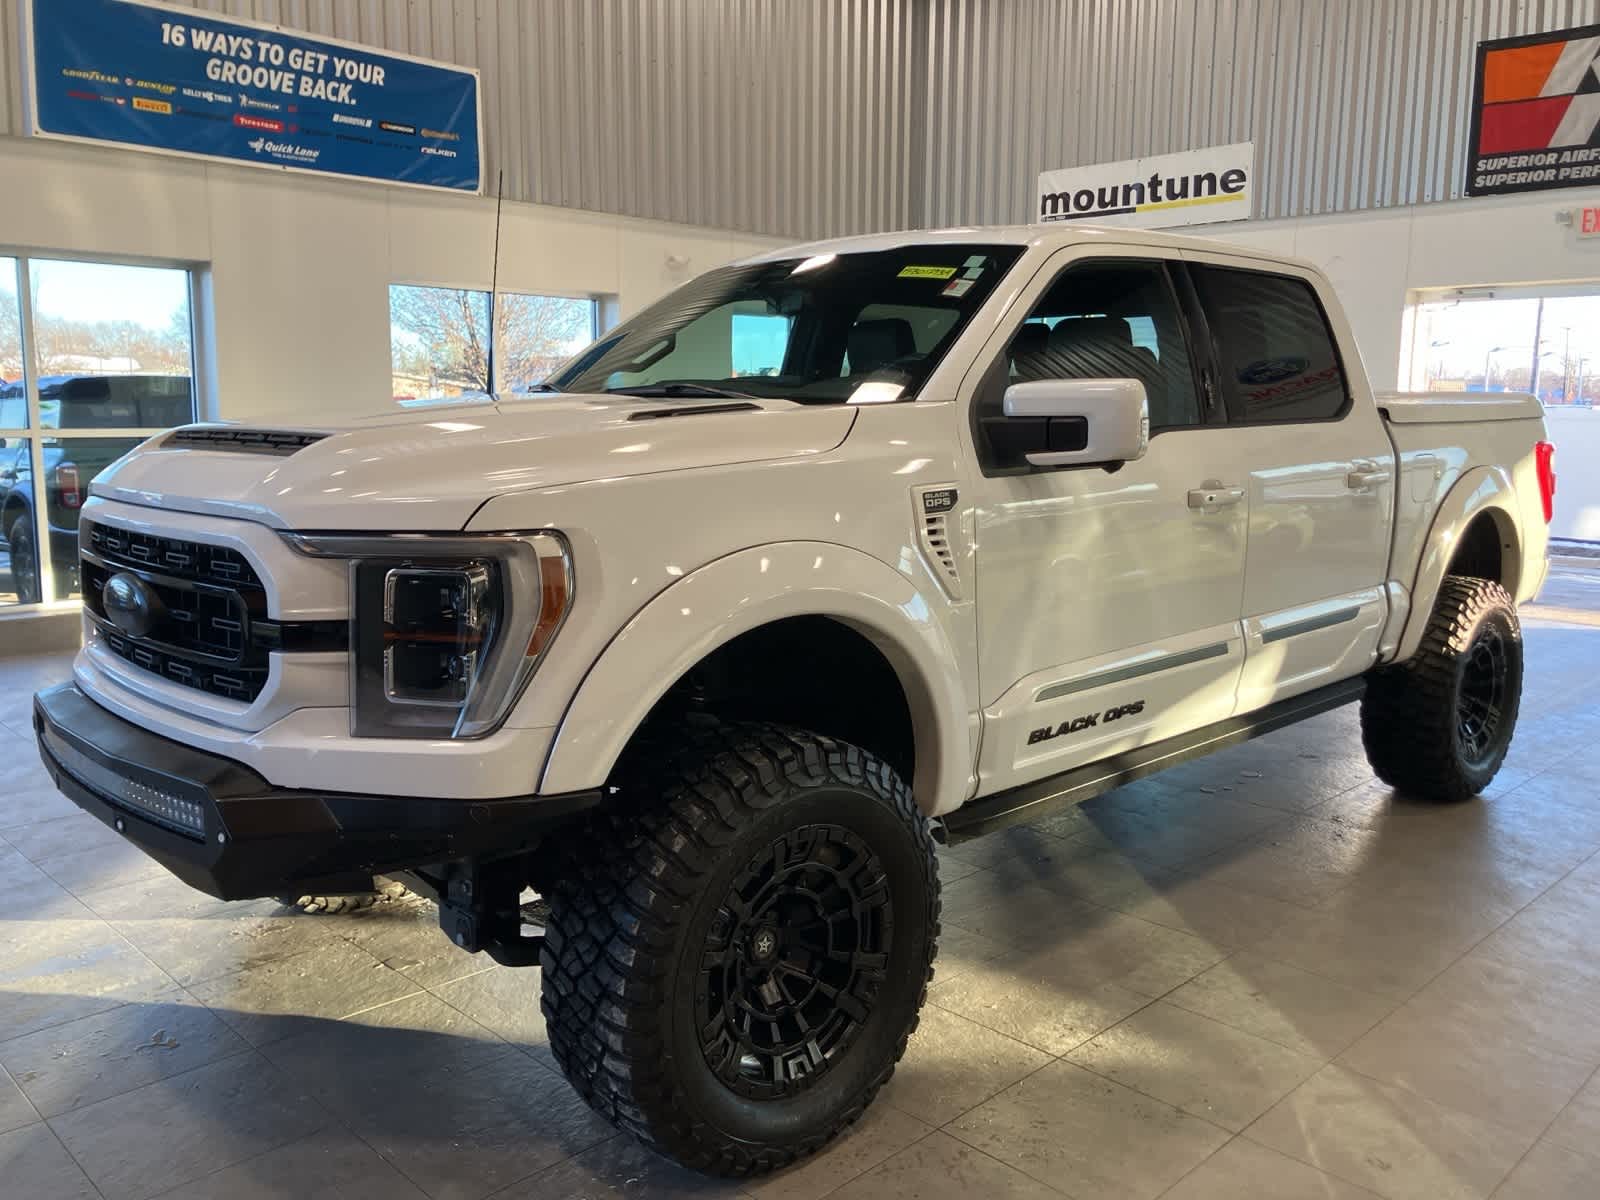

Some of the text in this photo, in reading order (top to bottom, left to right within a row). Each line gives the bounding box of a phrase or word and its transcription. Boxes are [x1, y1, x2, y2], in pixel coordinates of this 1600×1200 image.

[161, 22, 386, 87] 16 WAYS TO GET YOUR
[62, 68, 119, 84] GOODYEAR
[205, 57, 357, 106] GROOVE BACK.
[136, 80, 176, 95] DUNLOP
[239, 117, 280, 130] Firestone
[264, 141, 293, 154] Quick
[294, 145, 321, 158] Lane
[420, 146, 457, 159] FALKEN
[1476, 147, 1600, 172] SUPERIOR AIRF
[1474, 168, 1557, 188] SUPERIOR
[1040, 168, 1247, 216] mountune
[924, 491, 950, 500] BLACK
[926, 497, 951, 508] OPS
[1026, 699, 1145, 746] BLACK OPS
